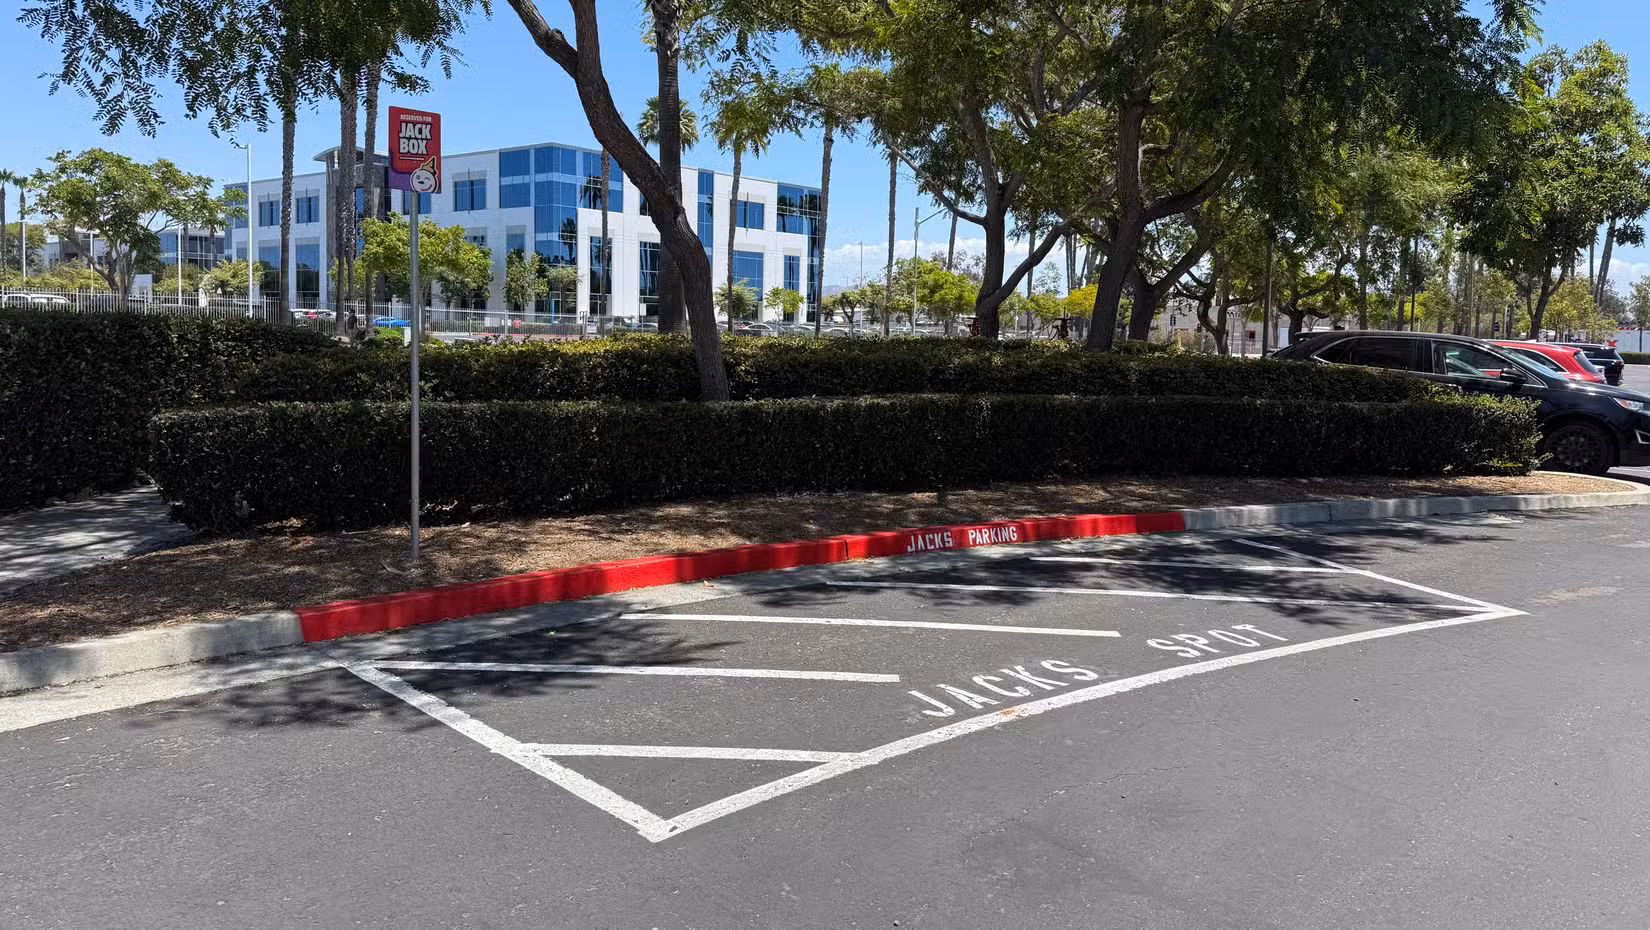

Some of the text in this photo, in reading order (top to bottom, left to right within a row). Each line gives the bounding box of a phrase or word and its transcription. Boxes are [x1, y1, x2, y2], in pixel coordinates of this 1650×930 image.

[399, 123, 431, 139] JACK
[399, 138, 428, 154] BOX
[907, 526, 1018, 552] JACKS PARKING
[908, 624, 1289, 717] JACKS SPOT
